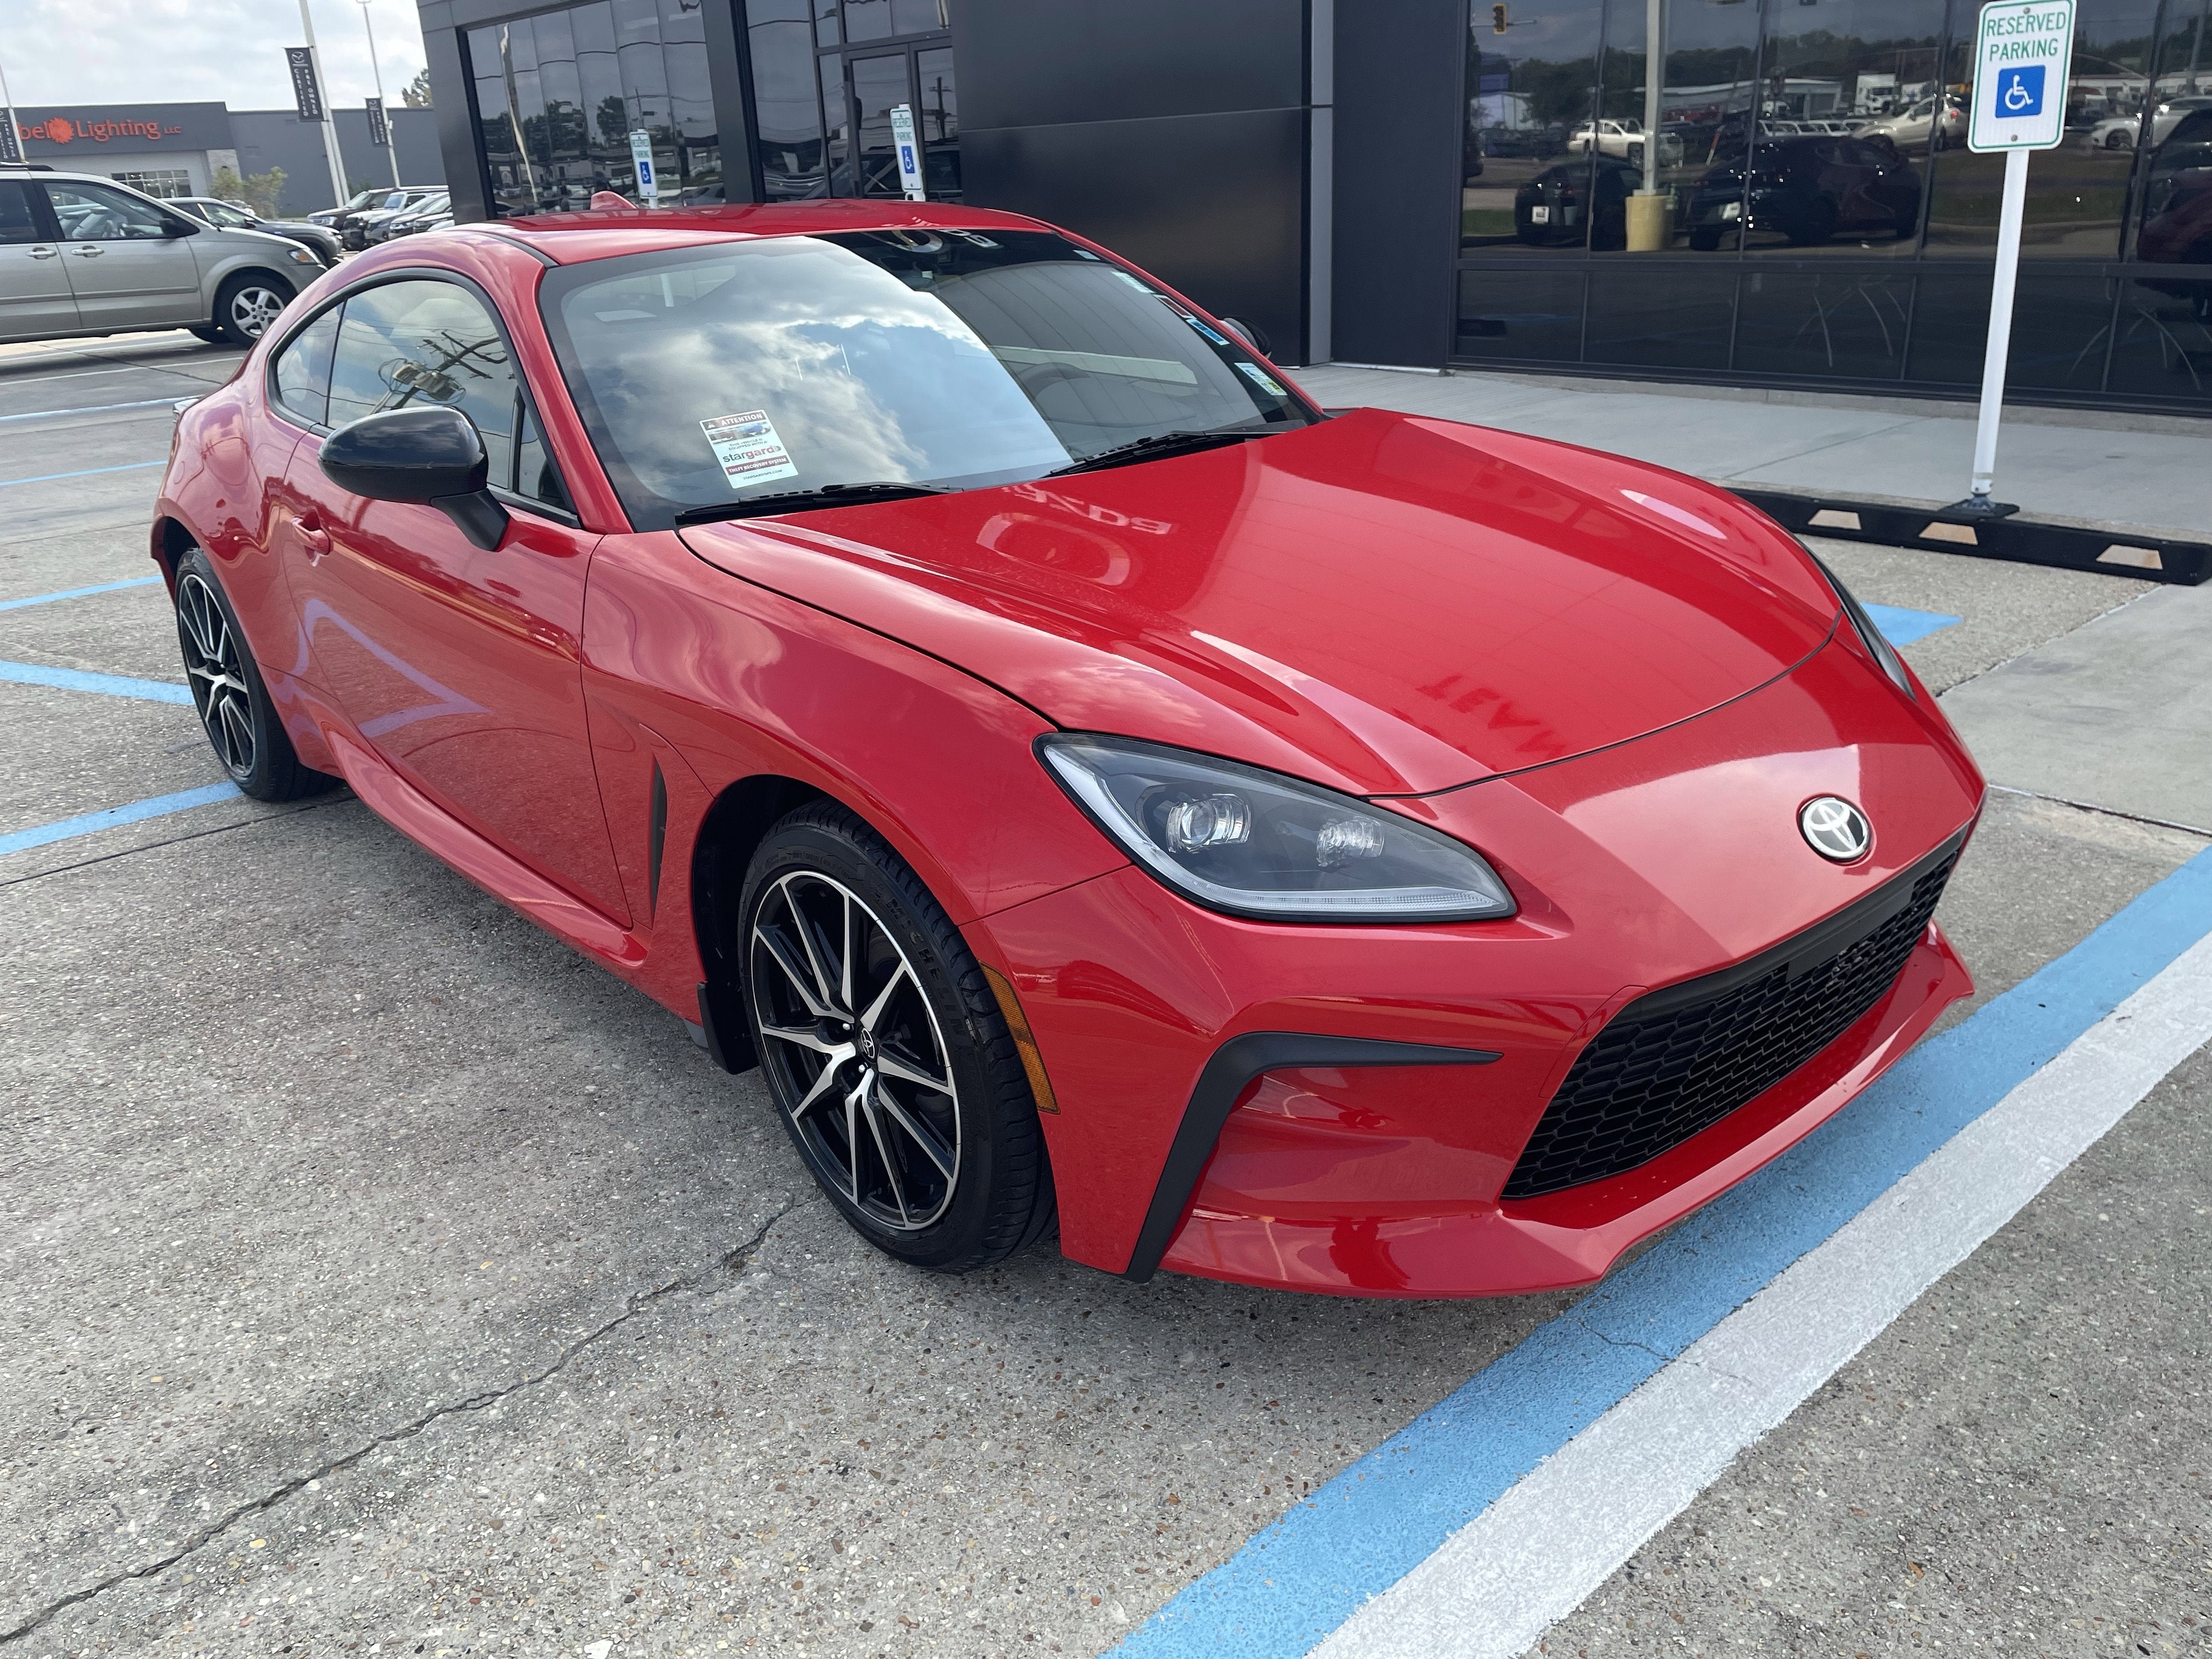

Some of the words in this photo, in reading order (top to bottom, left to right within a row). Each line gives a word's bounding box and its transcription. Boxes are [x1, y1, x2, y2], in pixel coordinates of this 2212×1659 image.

[1987, 12, 2066, 36] RESERVED
[1989, 38, 2058, 62] PARKING
[75, 119, 161, 142] Lighting
[721, 413, 763, 426] ATTENTION
[743, 461, 768, 470] RECOVERY
